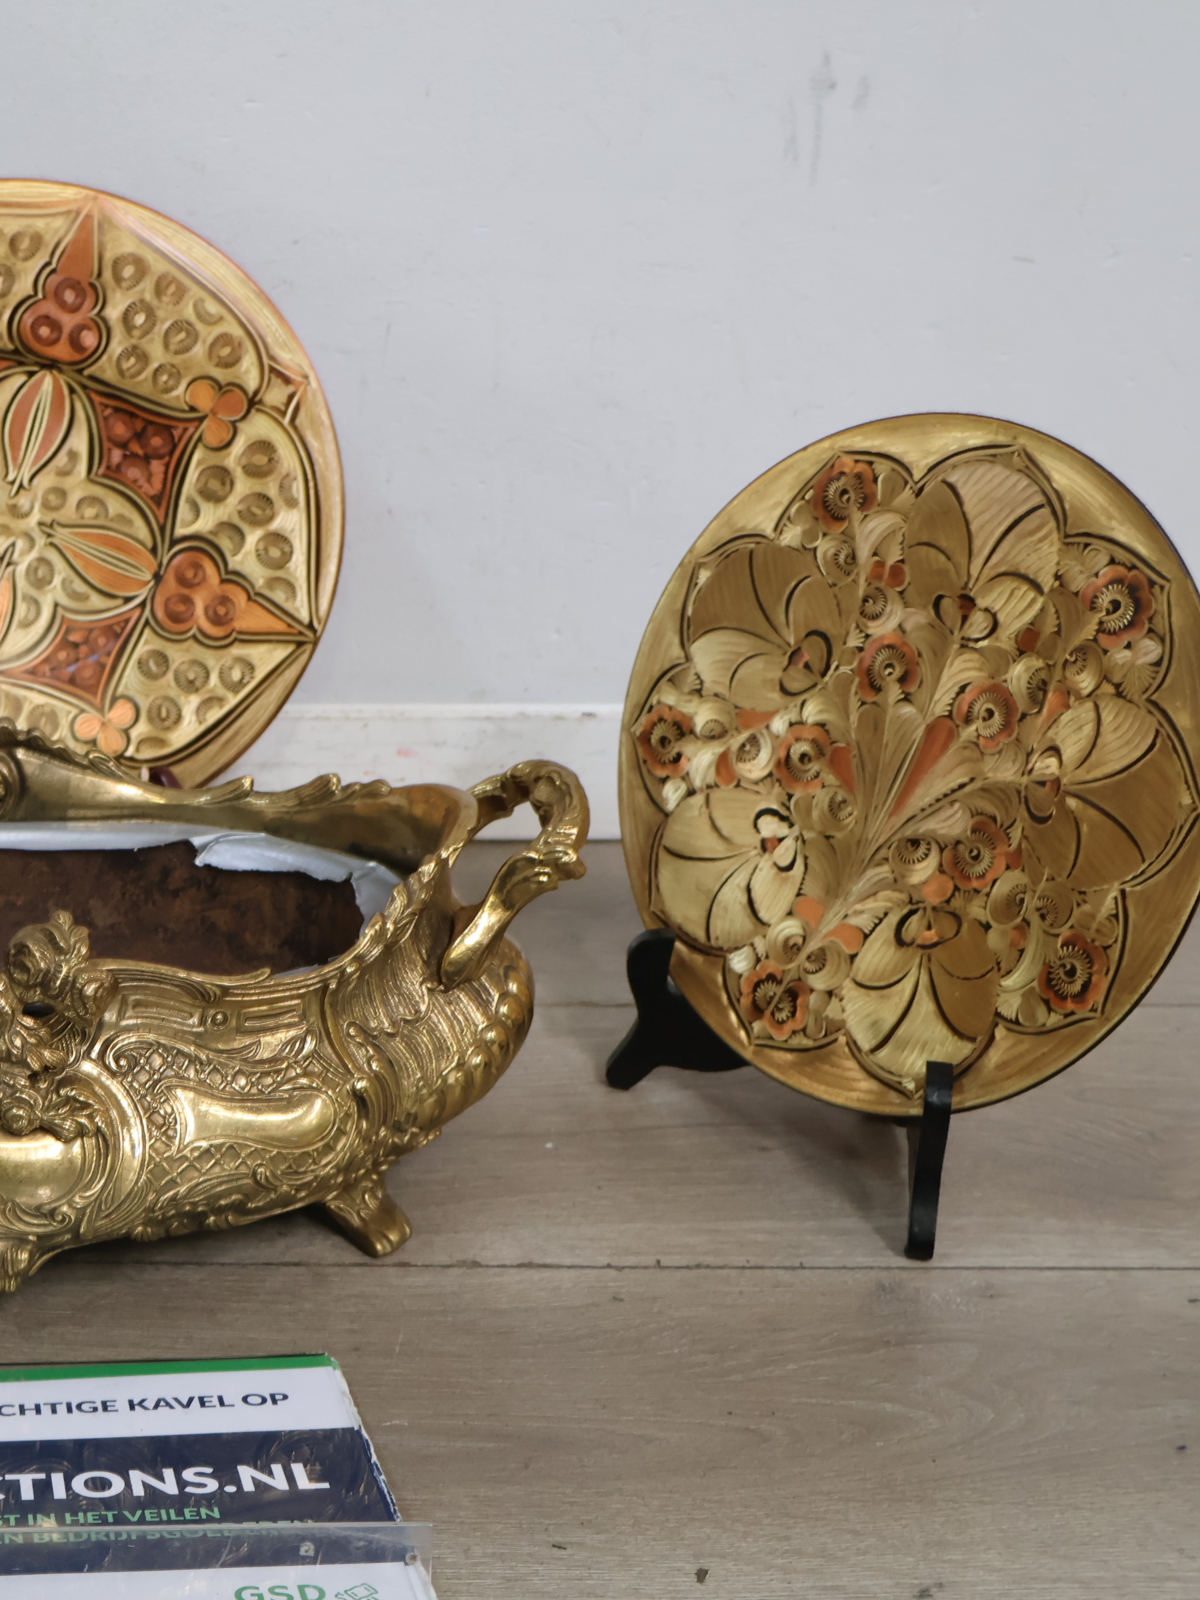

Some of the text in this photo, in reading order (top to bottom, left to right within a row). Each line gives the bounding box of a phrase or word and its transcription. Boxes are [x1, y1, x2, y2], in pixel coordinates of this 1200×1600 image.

[127, 1394, 235, 1412] KAVEL
[241, 1392, 290, 1407] OP
[27, 1512, 58, 1527] IN
[64, 1511, 118, 1525] HET
[122, 1506, 221, 1522] VEILEN
[234, 1584, 326, 1600] GSD
